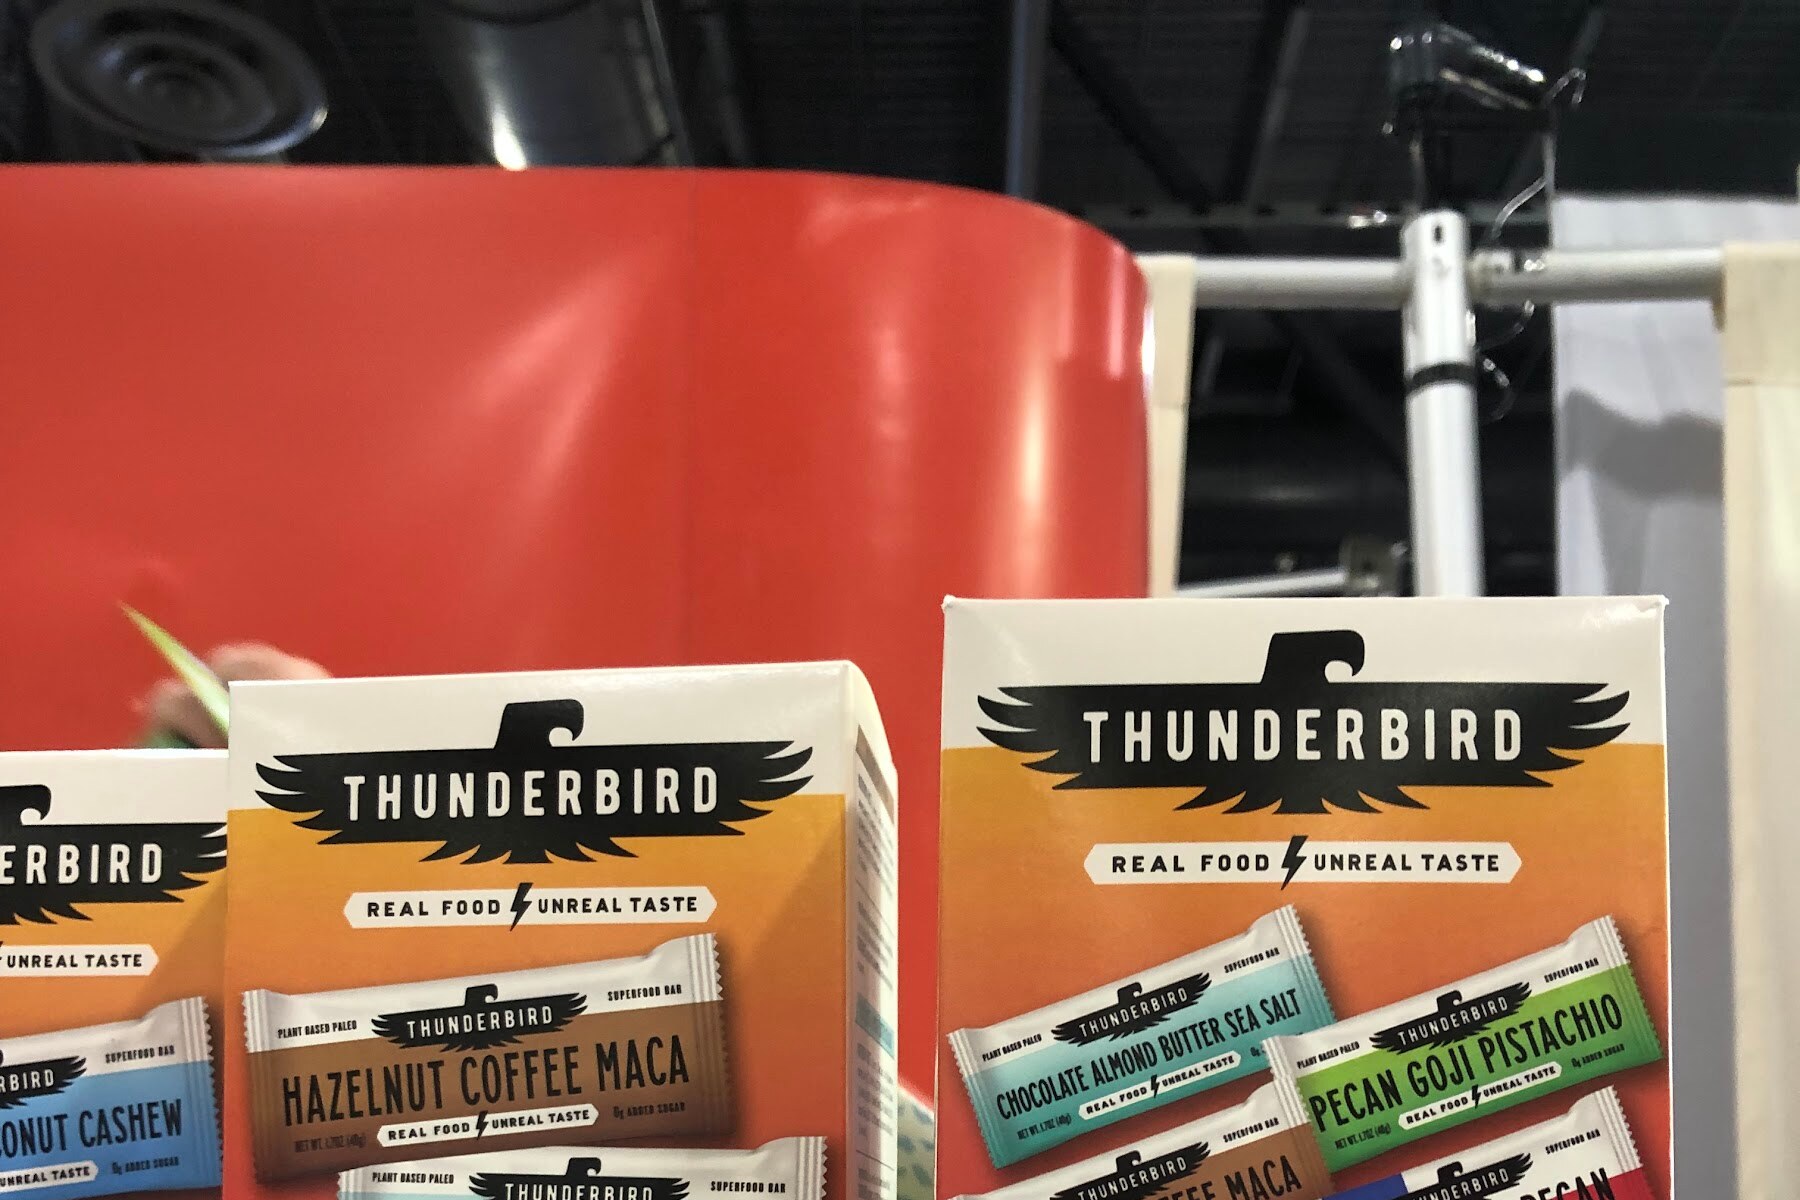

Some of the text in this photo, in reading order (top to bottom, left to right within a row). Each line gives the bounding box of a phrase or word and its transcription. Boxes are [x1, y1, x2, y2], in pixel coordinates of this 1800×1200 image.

[1083, 708, 1522, 763] THUNDERBIRD
[343, 766, 718, 821] THUNDERBIRD
[0, 843, 162, 885] ERBIRD
[1112, 853, 1500, 873] REAL FOOD UNREAL TASTE
[367, 896, 698, 917] REAL FOOD UNREAL TASTE
[7, 953, 142, 968] UNREAL TASTE
[607, 984, 682, 1002] SUPERFOOD BAR
[1079, 987, 1189, 1038] THUNDERBIRD
[406, 1006, 552, 1039] THUNDERBIRD
[1397, 996, 1509, 1046] THUNDERBIRD
[996, 988, 1302, 1120] CHOCOLATE ALMOND BUTTER SEA SALT
[1308, 993, 1624, 1133] PECAN GOJI PISTACHIO
[282, 1035, 690, 1127] HAZELNUT COFFEE MACA
[1086, 1056, 1235, 1115] REAL FOOD UNREAL TASTE
[0, 1099, 182, 1158] ONUT CASHEW
[388, 1109, 591, 1141] REAL FOOD UNREAL TASTE
[0, 1166, 90, 1187] UNREAL TASTE
[372, 1172, 454, 1184] PLANT BASED PALEO
[710, 1180, 786, 1193] SUPERFOOD BAR
